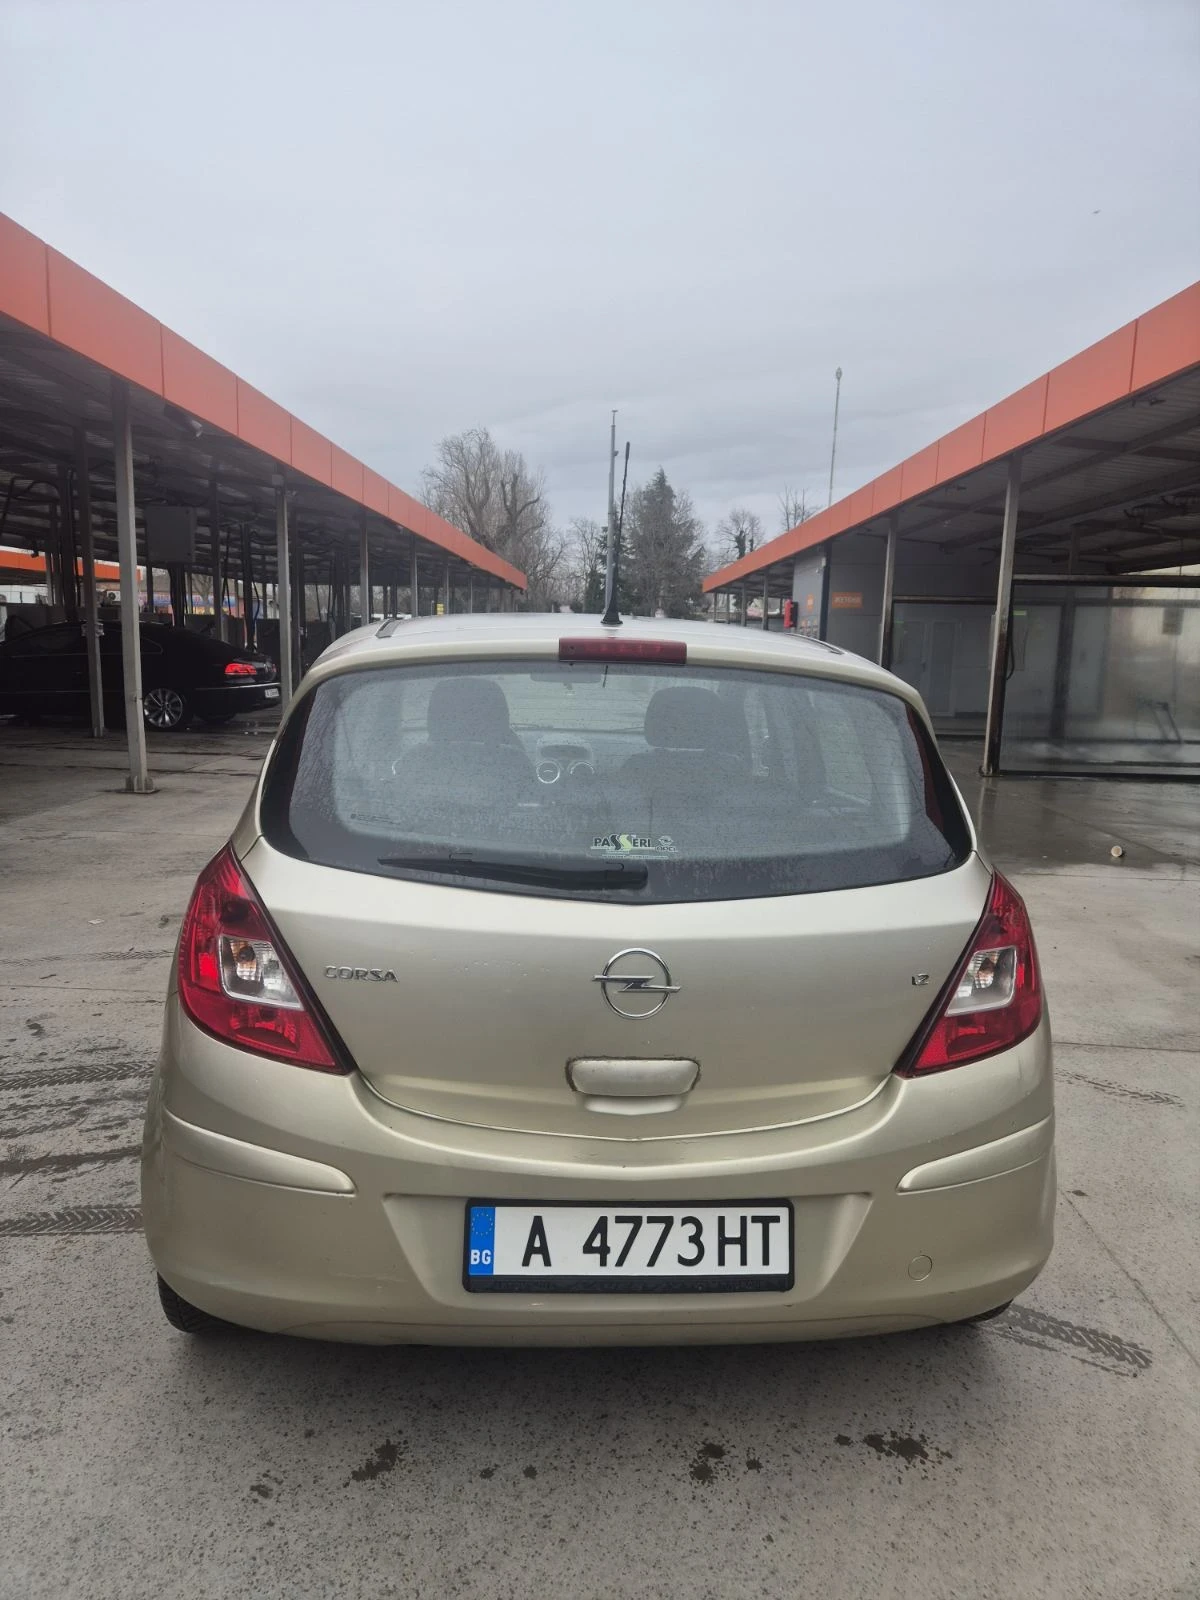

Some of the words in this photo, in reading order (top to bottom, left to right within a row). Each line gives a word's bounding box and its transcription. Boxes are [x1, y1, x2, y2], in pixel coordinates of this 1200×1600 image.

[593, 834, 651, 851] PASSERI
[324, 965, 398, 982] CORSA
[522, 1215, 552, 1268] A
[470, 1249, 492, 1265] BG
